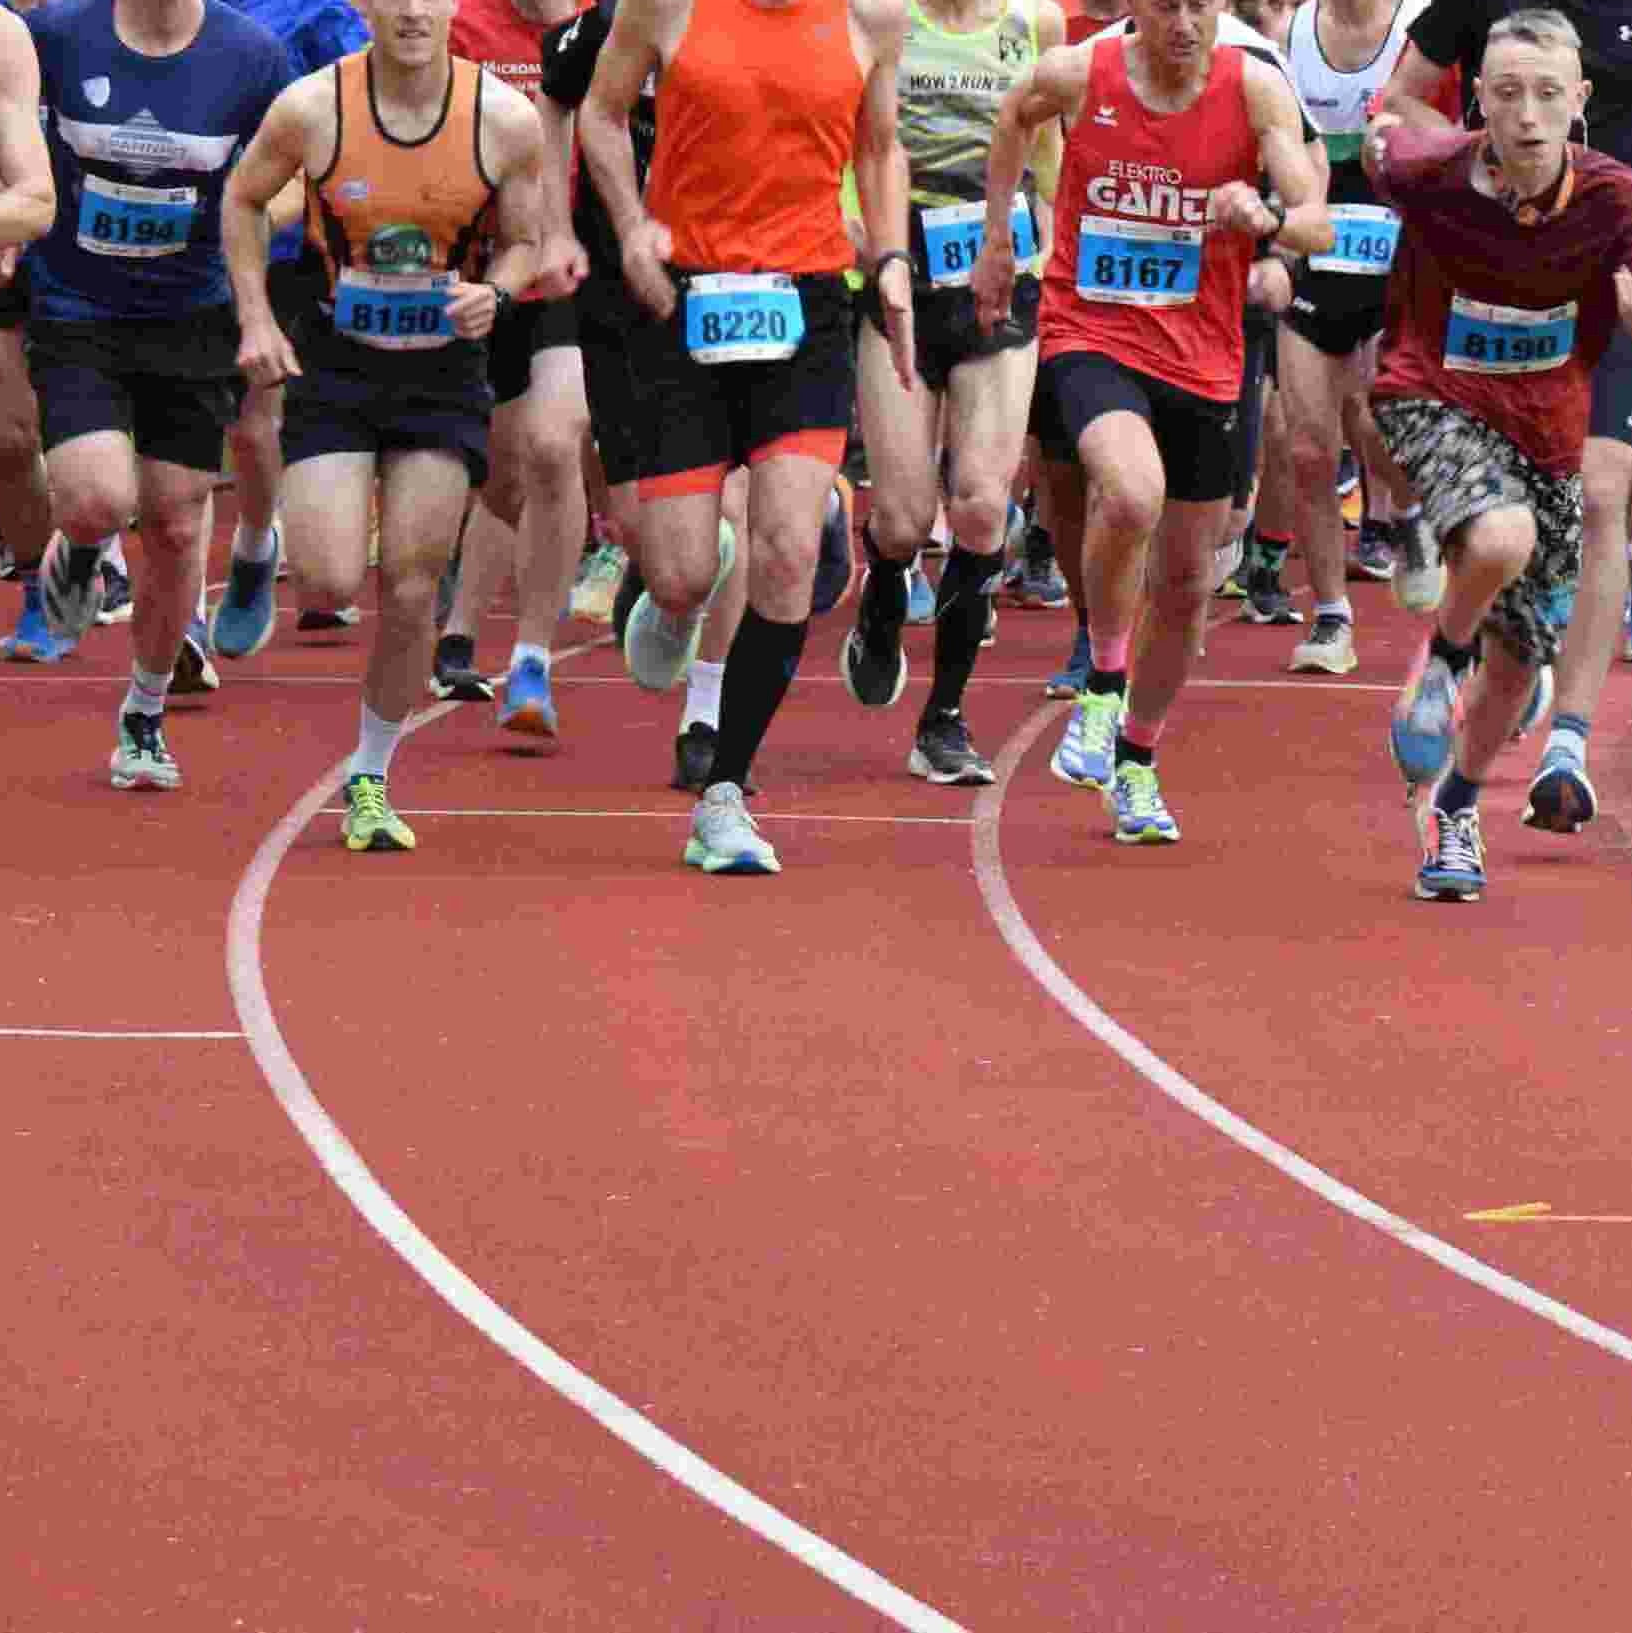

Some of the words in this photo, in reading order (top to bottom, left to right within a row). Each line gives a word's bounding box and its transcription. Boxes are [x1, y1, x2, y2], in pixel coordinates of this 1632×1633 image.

[1107, 159, 1183, 184] ELEKTRO
[1341, 234, 1391, 263] 149
[1095, 254, 1183, 289] 8167
[702, 309, 786, 344] 8220
